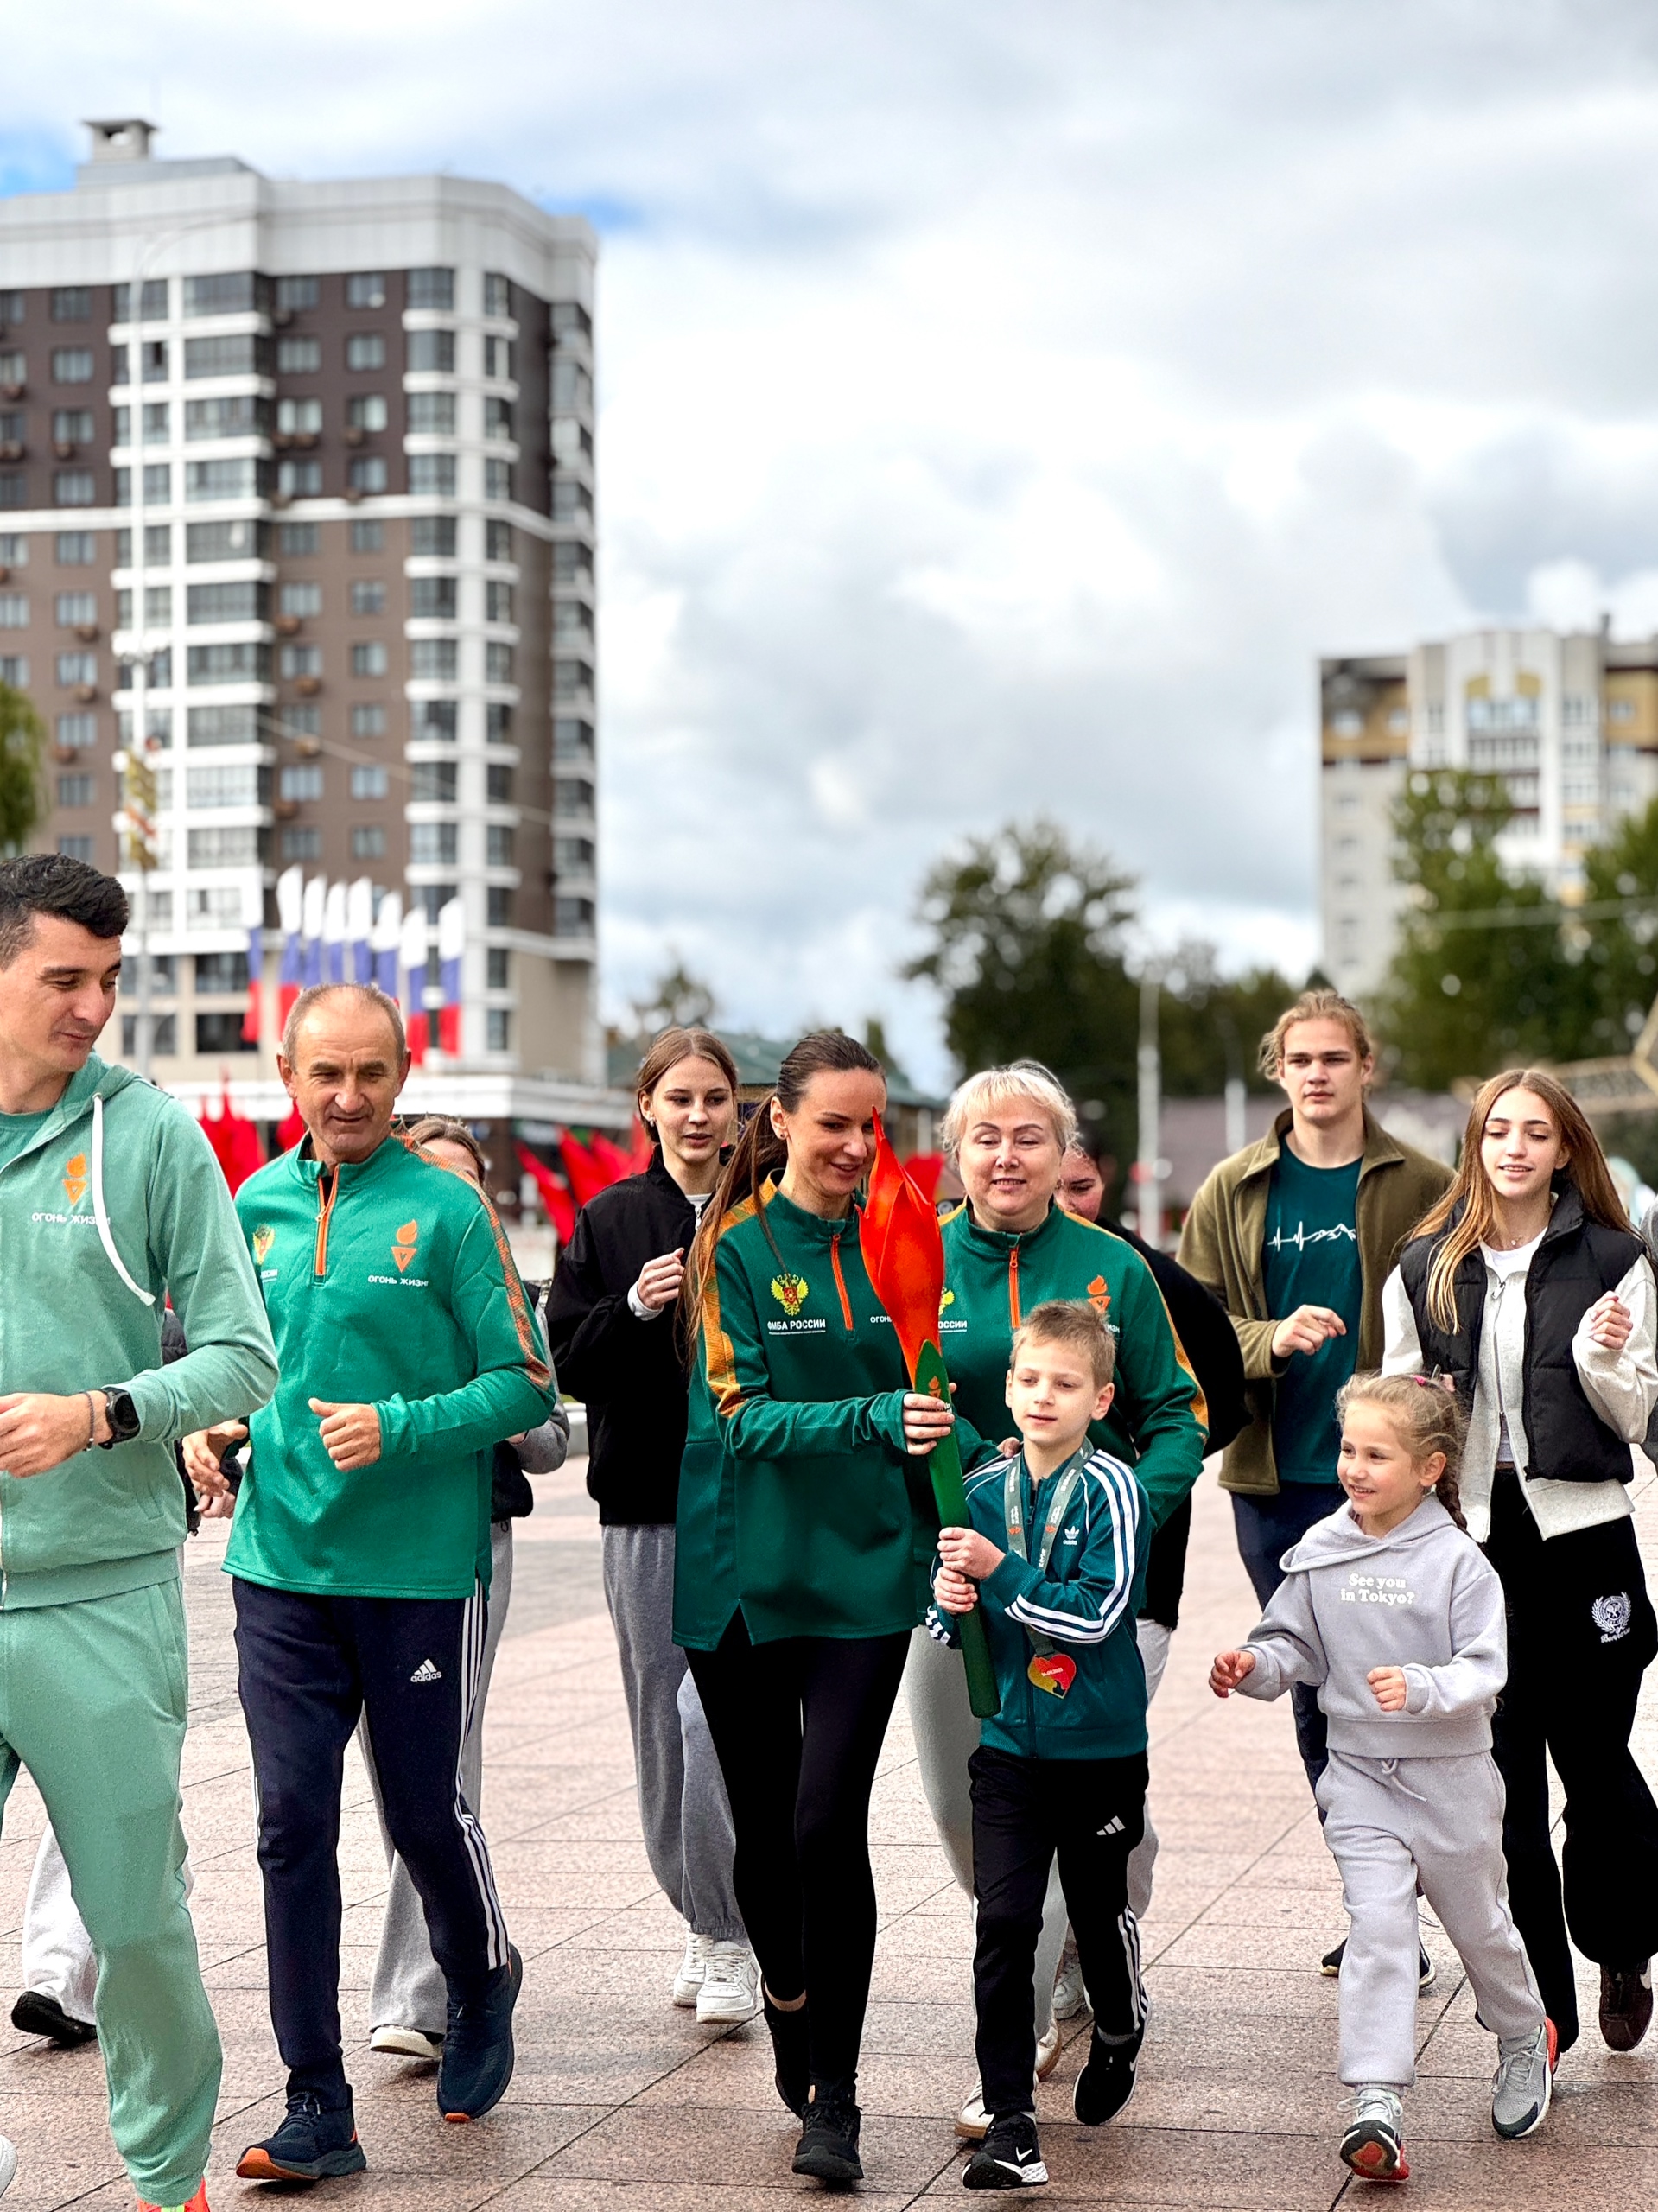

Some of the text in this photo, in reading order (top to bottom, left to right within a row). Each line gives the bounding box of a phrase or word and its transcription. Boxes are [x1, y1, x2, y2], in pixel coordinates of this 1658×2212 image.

[32, 1212, 67, 1223] ОГОНЬ
[368, 1274, 397, 1285] ОГОНЬ
[767, 1319, 826, 1331] ФМБА РОССИИ
[938, 1320, 968, 1329] ОССИИ
[1349, 1573, 1407, 1590] See you
[1340, 1588, 1415, 1606] in Tokyo?
[410, 1671, 442, 1683] adidas
